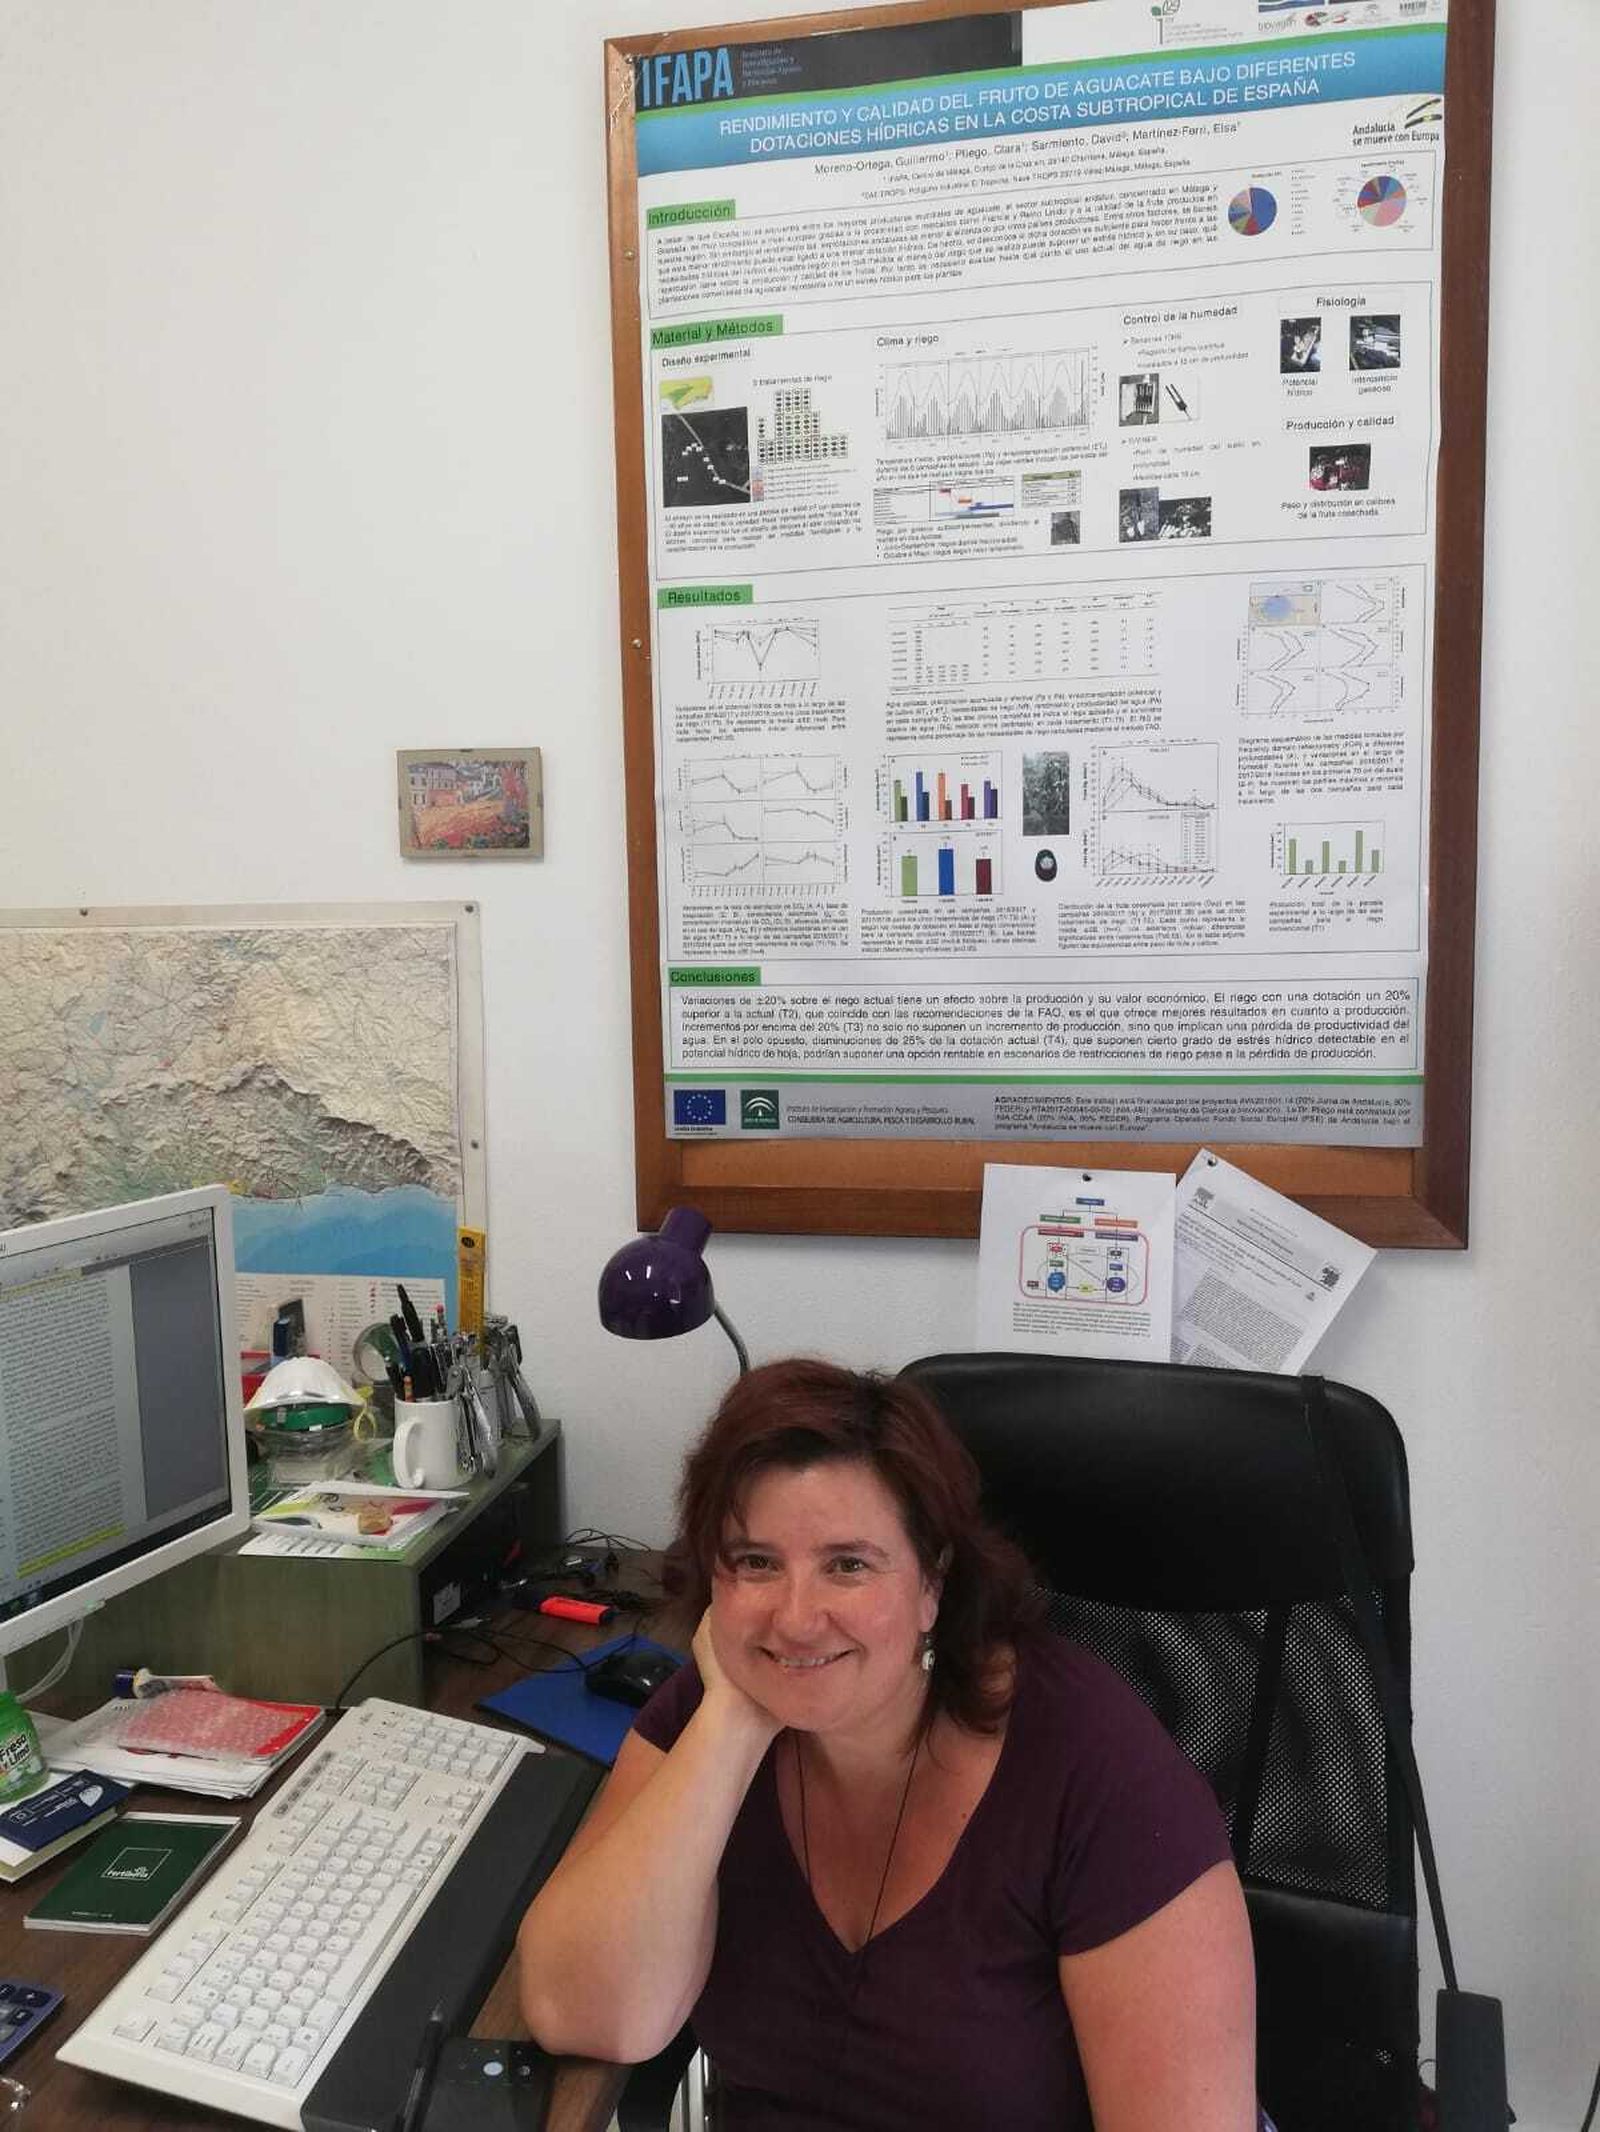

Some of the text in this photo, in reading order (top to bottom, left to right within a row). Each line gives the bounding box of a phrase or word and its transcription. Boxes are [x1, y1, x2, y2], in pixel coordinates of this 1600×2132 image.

[642, 47, 734, 107] IFAPA
[719, 51, 1355, 138] RENDIMIENTO Y CALIDAD DEL FRUTO DE AGUACATE BAJO DIFERENTES
[750, 75, 1319, 153] DOTACIONES HÍDRICAS EN LA COSTA SUBTROPICAL DE ESPAÑA
[1352, 130, 1439, 146] se mueve con Europa
[648, 205, 730, 225] Introducción
[1316, 296, 1366, 308] Fisiología
[1123, 306, 1238, 325] Control de la humedad
[652, 320, 773, 344] Material y Métodos
[876, 334, 939, 348] Clima y riego
[662, 349, 750, 367] Diseño experimental
[1286, 416, 1394, 431] Producción y calidad
[668, 590, 741, 603] Resultados
[671, 970, 755, 983] Conclusiones
[681, 995, 736, 1006] Variaciones
[790, 995, 818, 1006] sobre
[834, 996, 857, 1007] riego
[863, 994, 896, 1005] actual
[896, 994, 923, 1005] tiene
[943, 993, 975, 1005] efecto
[978, 993, 1008, 1004] sobre
[1025, 993, 1083, 1006] producción
[1115, 993, 1142, 1003] valor
[1146, 991, 1209, 1004] económico.
[1230, 993, 1258, 1005] riego
[1262, 993, 1282, 1002] con
[1287, 992, 1309, 1001] una
[1312, 990, 1361, 1002] dotación
[1384, 990, 1410, 1001] 20%
[681, 1008, 720, 1021] superior
[746, 1007, 774, 1018] actual
[778, 1007, 801, 1021] (T2),
[804, 1009, 824, 1021] que
[827, 1008, 869, 1019] coincide
[871, 1010, 890, 1019] con
[894, 1008, 909, 1019] las
[912, 1008, 1002, 1019] recomendaciones
[1099, 1007, 1119, 1019] que
[1123, 1007, 1159, 1019] ofrece
[1161, 1008, 1206, 1019] mejores
[1209, 1005, 1267, 1018] resultados
[1289, 1005, 1329, 1017] cuanto
[1344, 1004, 1408, 1018] producción.
[681, 1021, 741, 1032] Incrementos
[741, 1023, 759, 1033] por
[761, 1022, 797, 1032] encima
[799, 1020, 815, 1032] del
[817, 1021, 840, 1033] 20%
[843, 1021, 864, 1035] (T3)
[921, 1022, 967, 1034] suponen
[985, 1022, 1044, 1032] incremento
[1063, 1020, 1124, 1034] producción,
[1128, 1023, 1151, 1031] sino
[1154, 1023, 1174, 1033] que
[1177, 1020, 1223, 1033] implican
[1225, 1022, 1247, 1031] una
[1251, 1019, 1293, 1033] pérdida
[1313, 1018, 1390, 1033] productividad
[1392, 1018, 1409, 1030] del
[741, 1035, 765, 1046] polo
[766, 1035, 808, 1047] opuesto,
[811, 1035, 882, 1047] disminuciones
[902, 1034, 926, 1045] 25%
[959, 1035, 1003, 1046] dotación
[1007, 1034, 1039, 1046] actual
[1043, 1033, 1069, 1046] (T4),
[1072, 1036, 1093, 1047] que
[1096, 1036, 1143, 1046] suponen
[1147, 1035, 1177, 1046] cierto
[1181, 1035, 1213, 1047] grado
[1236, 1034, 1270, 1045] estrés
[1275, 1033, 1313, 1045] hídrico
[1318, 1033, 1376, 1044] detectable
